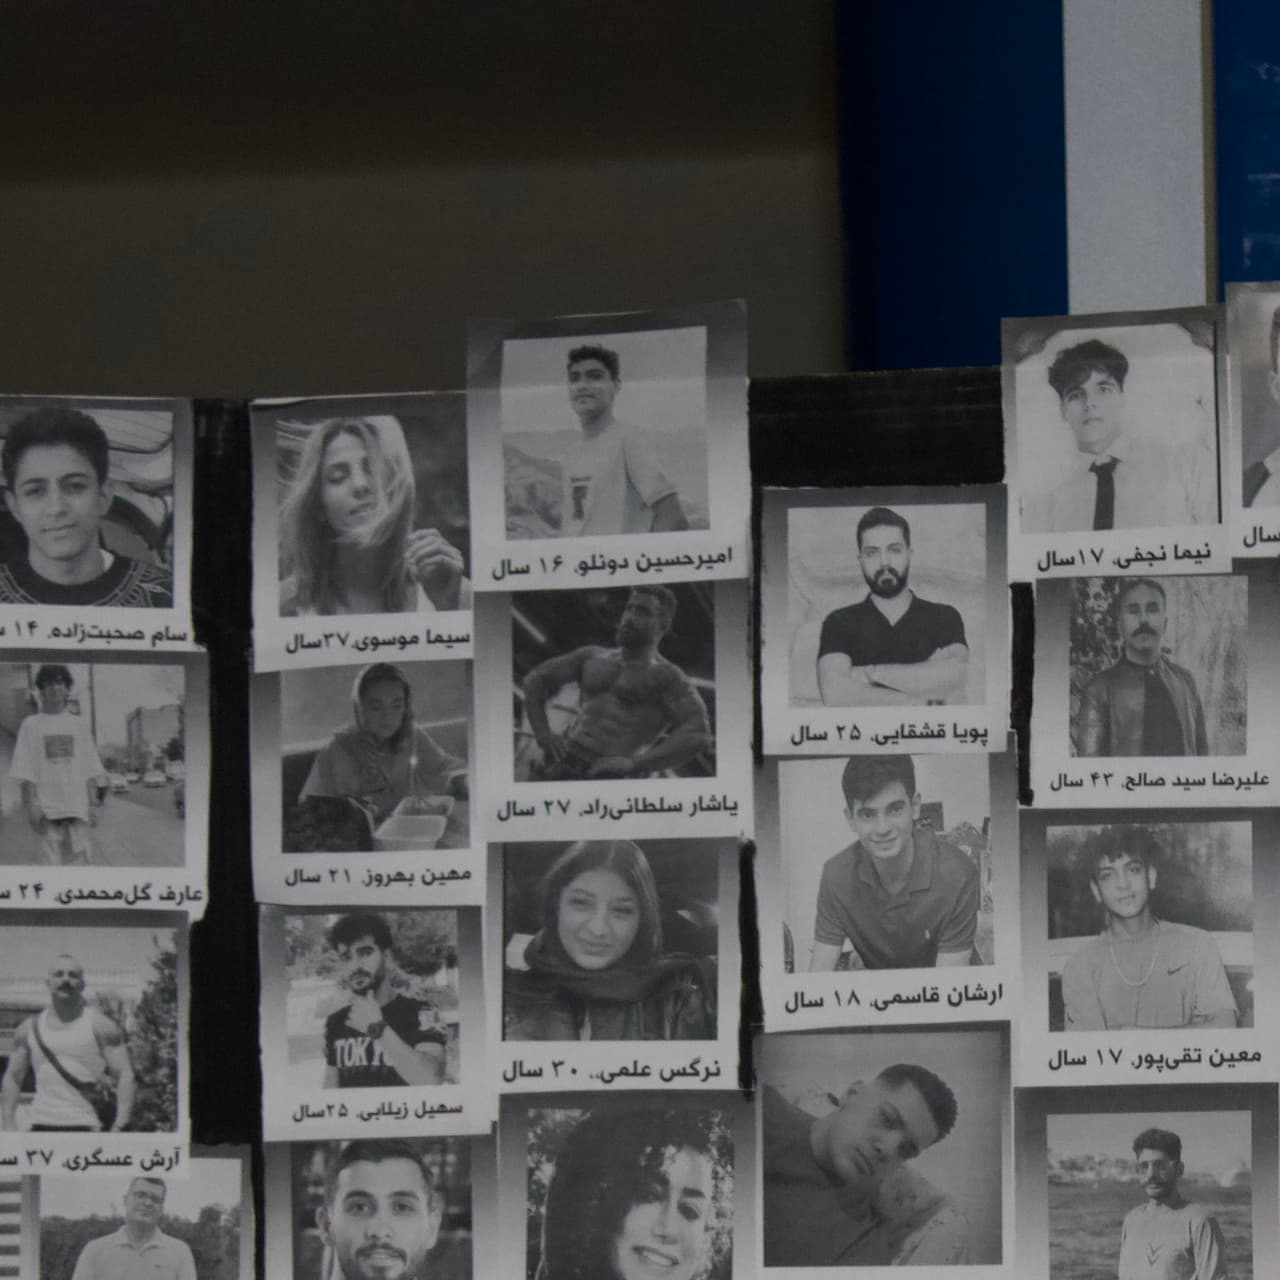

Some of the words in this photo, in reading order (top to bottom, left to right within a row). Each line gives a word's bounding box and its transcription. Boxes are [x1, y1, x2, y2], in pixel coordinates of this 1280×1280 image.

[540, 555, 563, 572] ۱۶
[636, 547, 732, 573] امیرحسین
[492, 559, 530, 581] سال
[15, 621, 38, 635] ۱۴
[151, 626, 187, 647] سام
[791, 725, 828, 746] سال
[836, 724, 861, 740] ۲۵
[953, 723, 988, 743] پویا
[1050, 773, 1083, 792] سال
[1090, 772, 1114, 786] ۴۳
[1172, 776, 1206, 791] سید
[1212, 771, 1269, 790] علیرضا
[497, 800, 535, 822] سال
[544, 800, 570, 814] ۲۷
[689, 795, 738, 817] یاشار
[285, 869, 321, 887] سال
[329, 869, 350, 882] ۲۱
[159, 885, 202, 906] عارف
[785, 992, 824, 1014] سال
[835, 990, 860, 1006] ۱۸
[947, 984, 1003, 1007] ارشان
[1048, 1050, 1087, 1071] سال
[1097, 1048, 1122, 1064] ۱۷
[1209, 1051, 1261, 1068] معین
[26, 1150, 53, 1165] ۳۷
[140, 1147, 180, 1172] آرش
